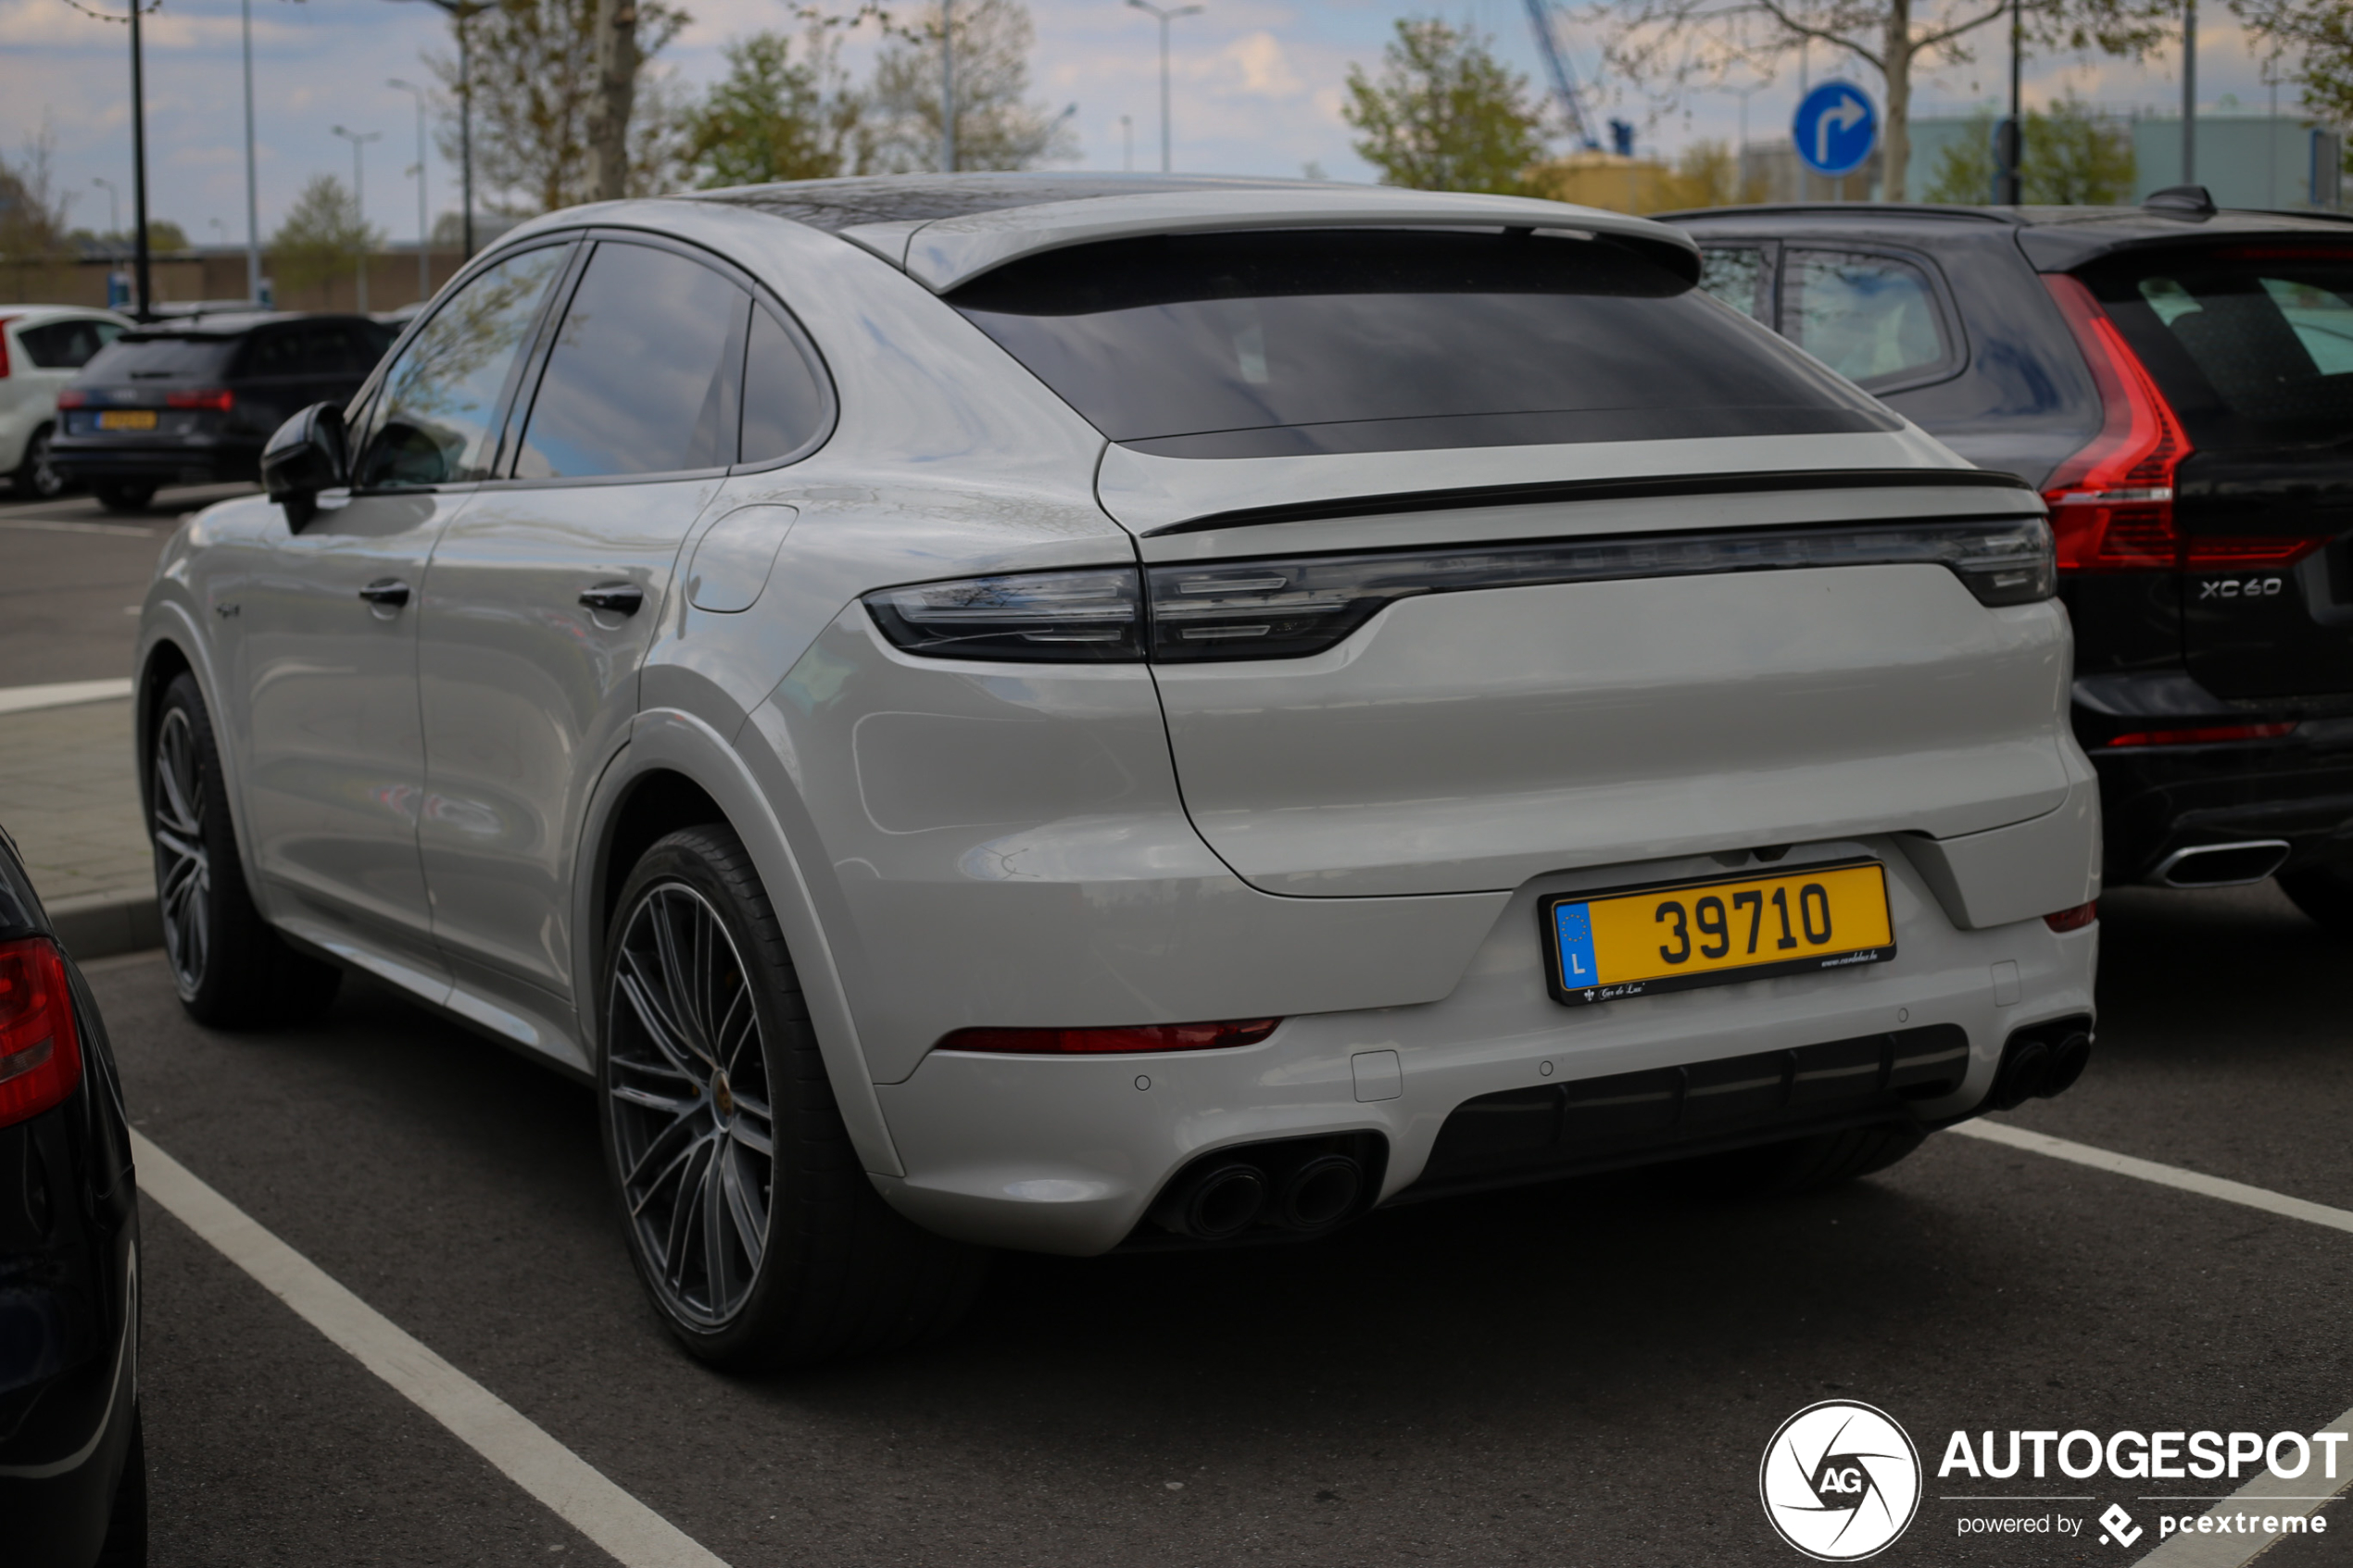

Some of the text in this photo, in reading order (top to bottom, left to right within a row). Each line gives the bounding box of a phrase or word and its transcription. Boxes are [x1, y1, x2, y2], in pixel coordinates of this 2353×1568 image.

[1655, 883, 1832, 964] 39710
[1571, 952, 1587, 974] L
[1616, 986, 1624, 996] de
